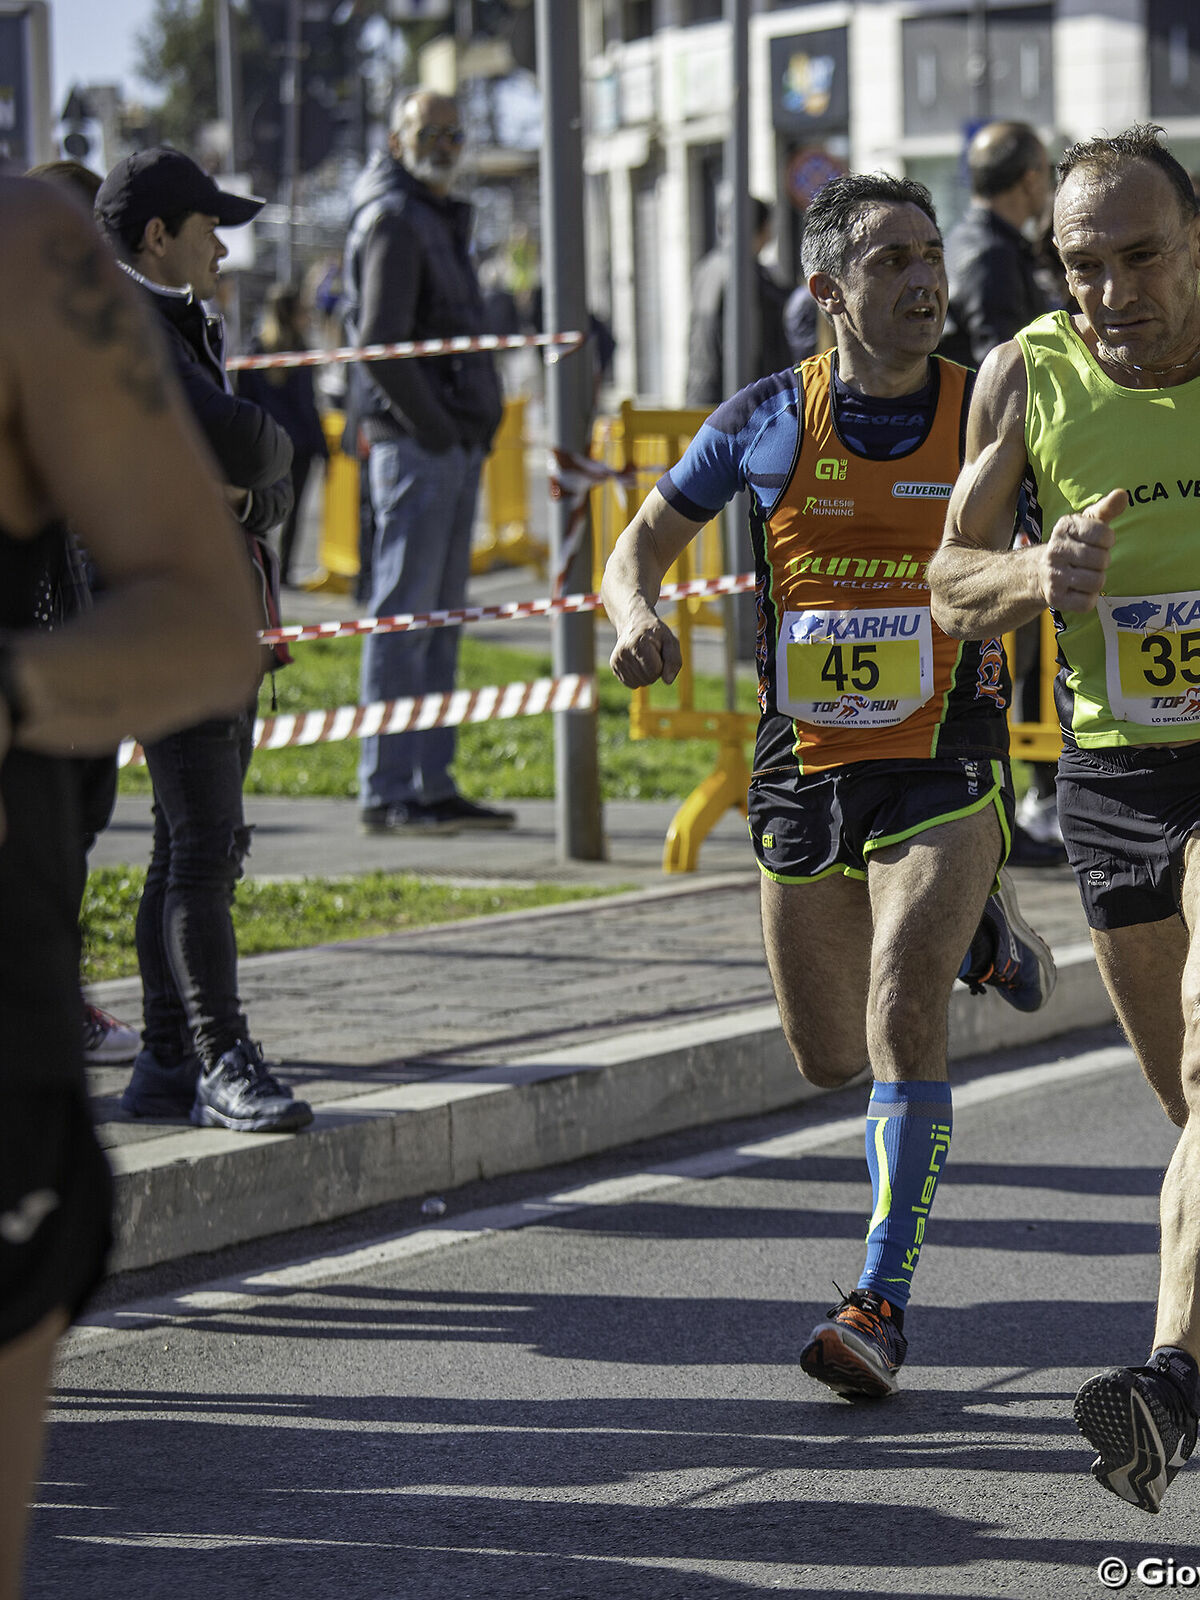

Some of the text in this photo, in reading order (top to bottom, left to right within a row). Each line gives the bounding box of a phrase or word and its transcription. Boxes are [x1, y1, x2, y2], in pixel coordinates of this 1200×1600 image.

[812, 508, 854, 517] RUNNING
[827, 614, 921, 640] KARHU
[821, 645, 880, 692] 45
[812, 699, 899, 713] TOP RUN
[1151, 695, 1186, 709] TOP
